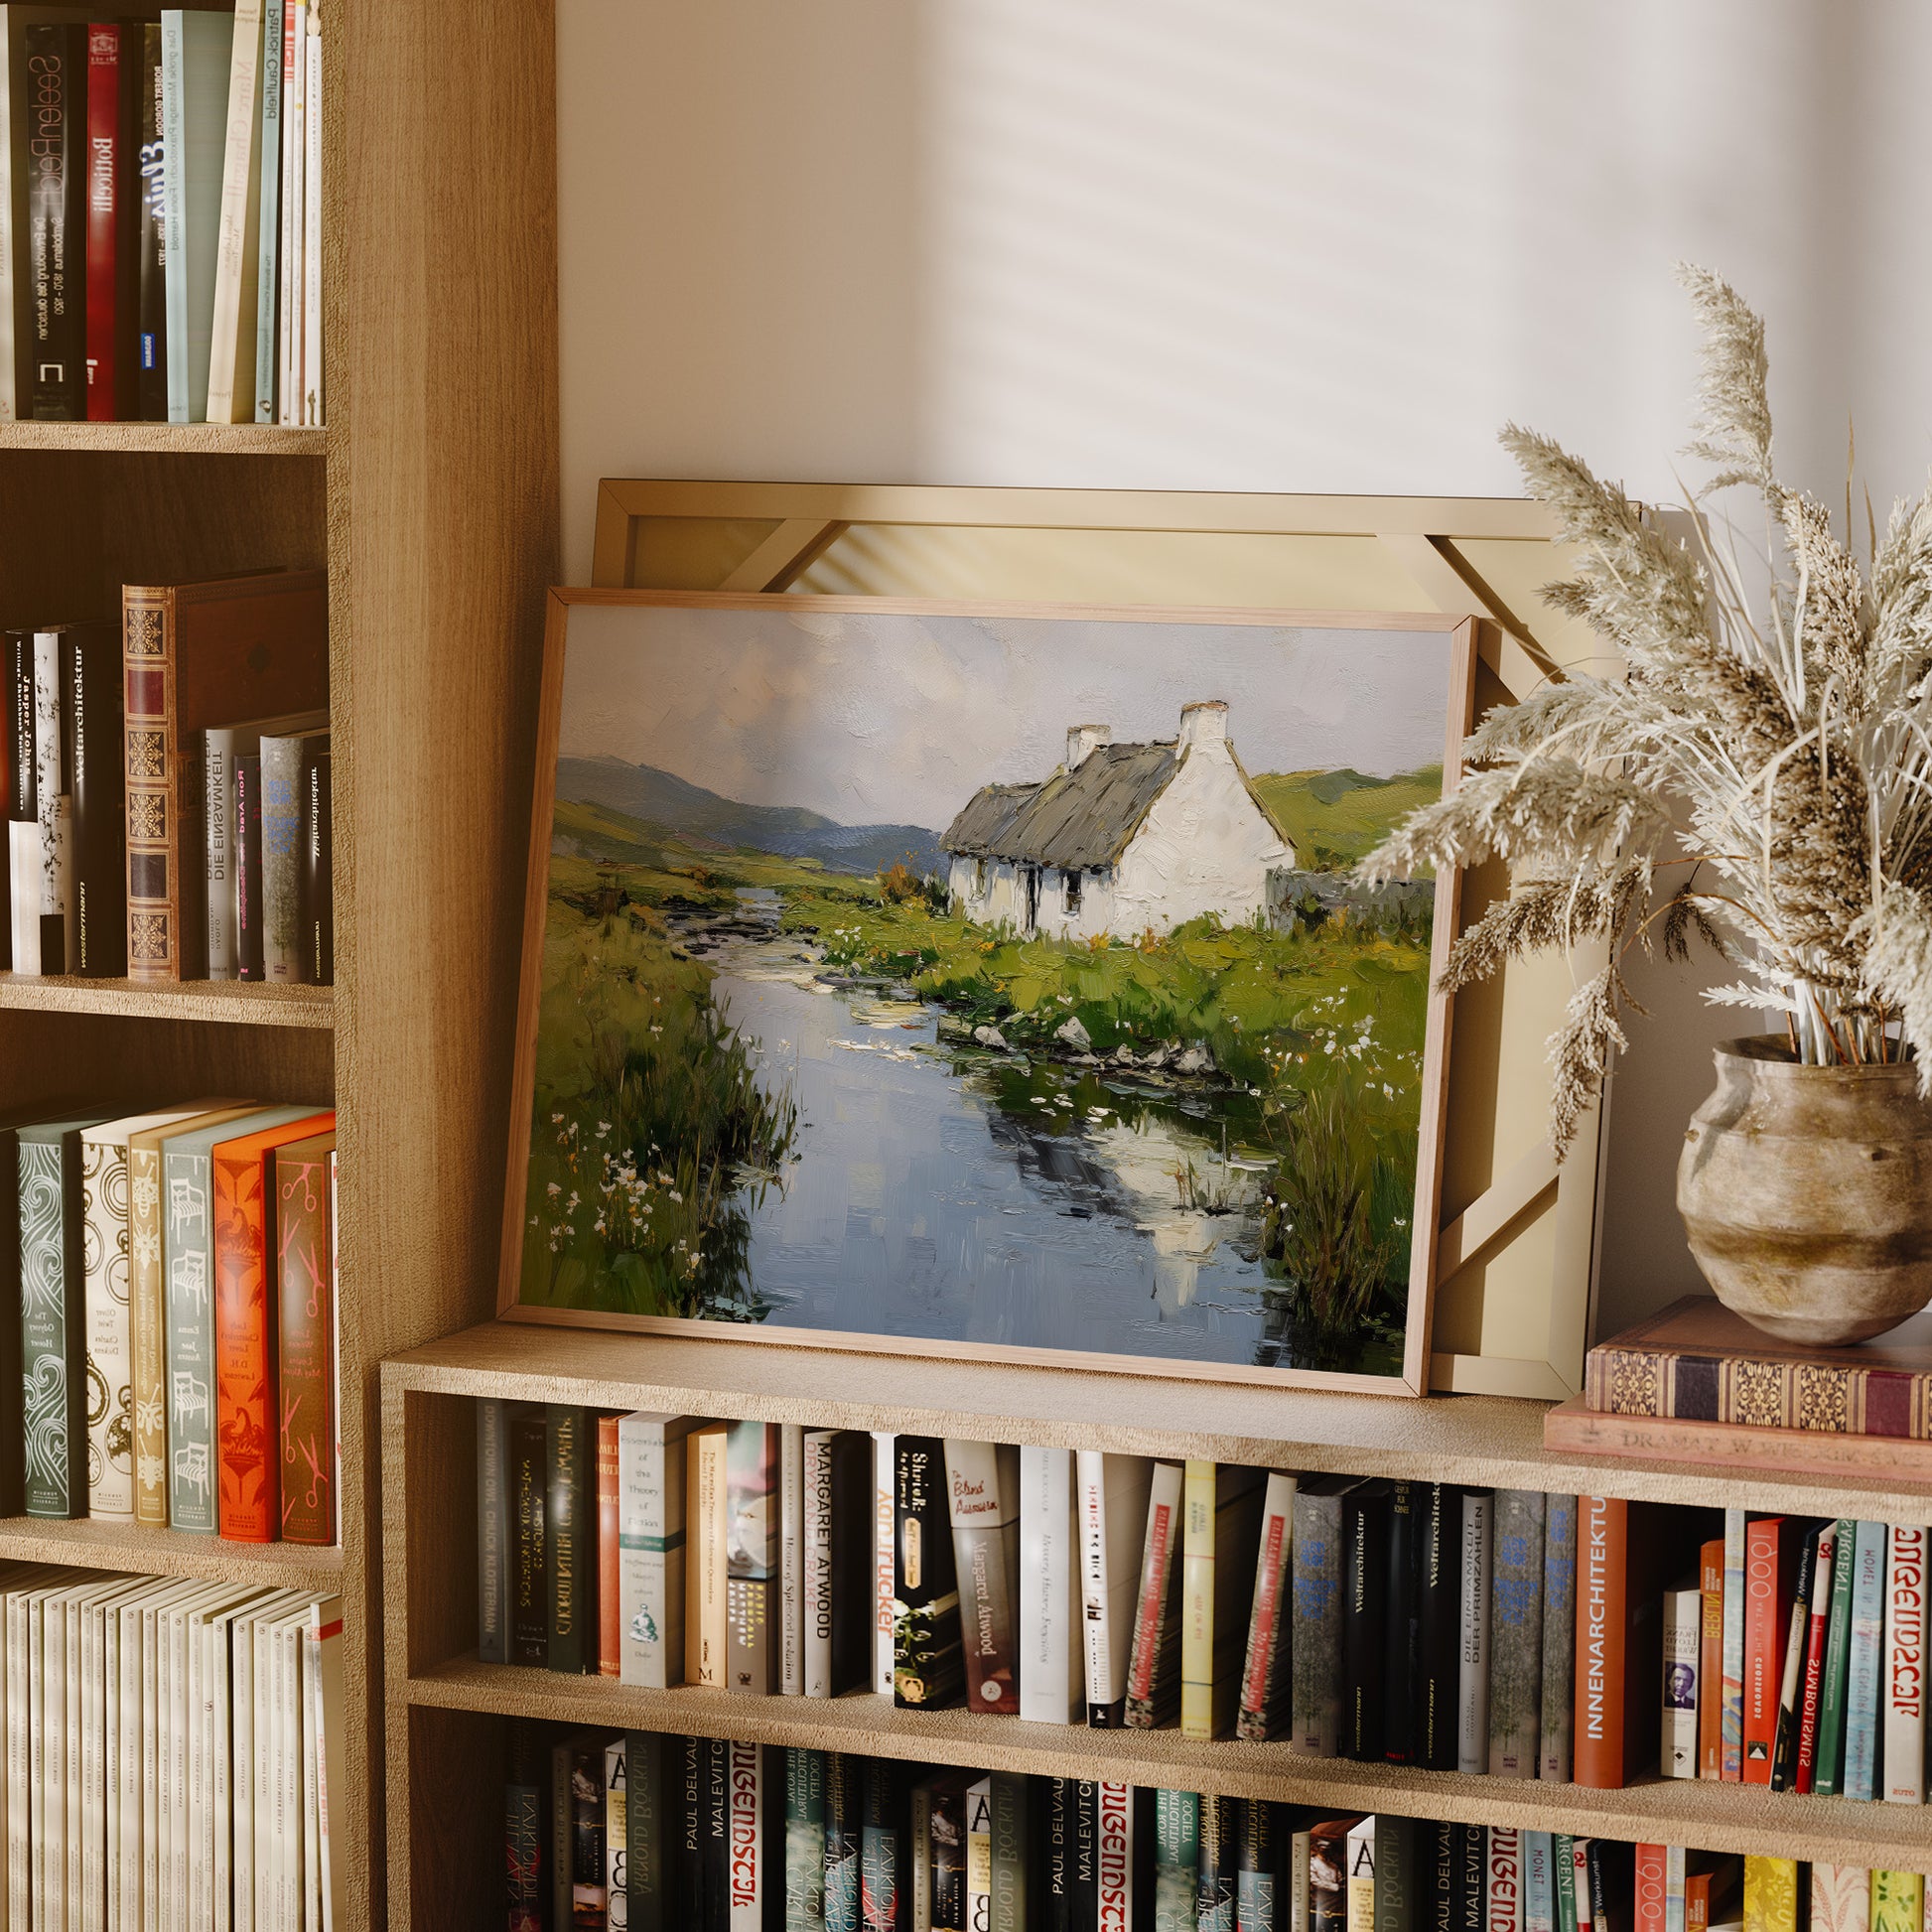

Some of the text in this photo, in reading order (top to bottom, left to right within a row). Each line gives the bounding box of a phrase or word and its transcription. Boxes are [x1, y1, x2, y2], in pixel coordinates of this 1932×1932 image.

[73, 646, 84, 782] Weltarchitektur
[483, 1406, 495, 1477] DOWNTOWN
[484, 1510, 496, 1551] CHUCK
[806, 1442, 816, 1612] ORYX AND CRAKE
[817, 1443, 831, 1639] MARGARET ATWOOD
[1355, 1511, 1365, 1613] Weltarchitektur
[1473, 1506, 1483, 1621] PRIMZAHLEN
[484, 1556, 497, 1633] KLOSTERMAN
[972, 1541, 997, 1655] Margaret Atwood
[1464, 1520, 1473, 1625] EINSAMKEIT
[687, 1812, 698, 1851] PAUL
[1052, 1851, 1064, 1894] PAUL
[1533, 1850, 1544, 1885] MONET
[1592, 1860, 1606, 1902] Werkkunst
